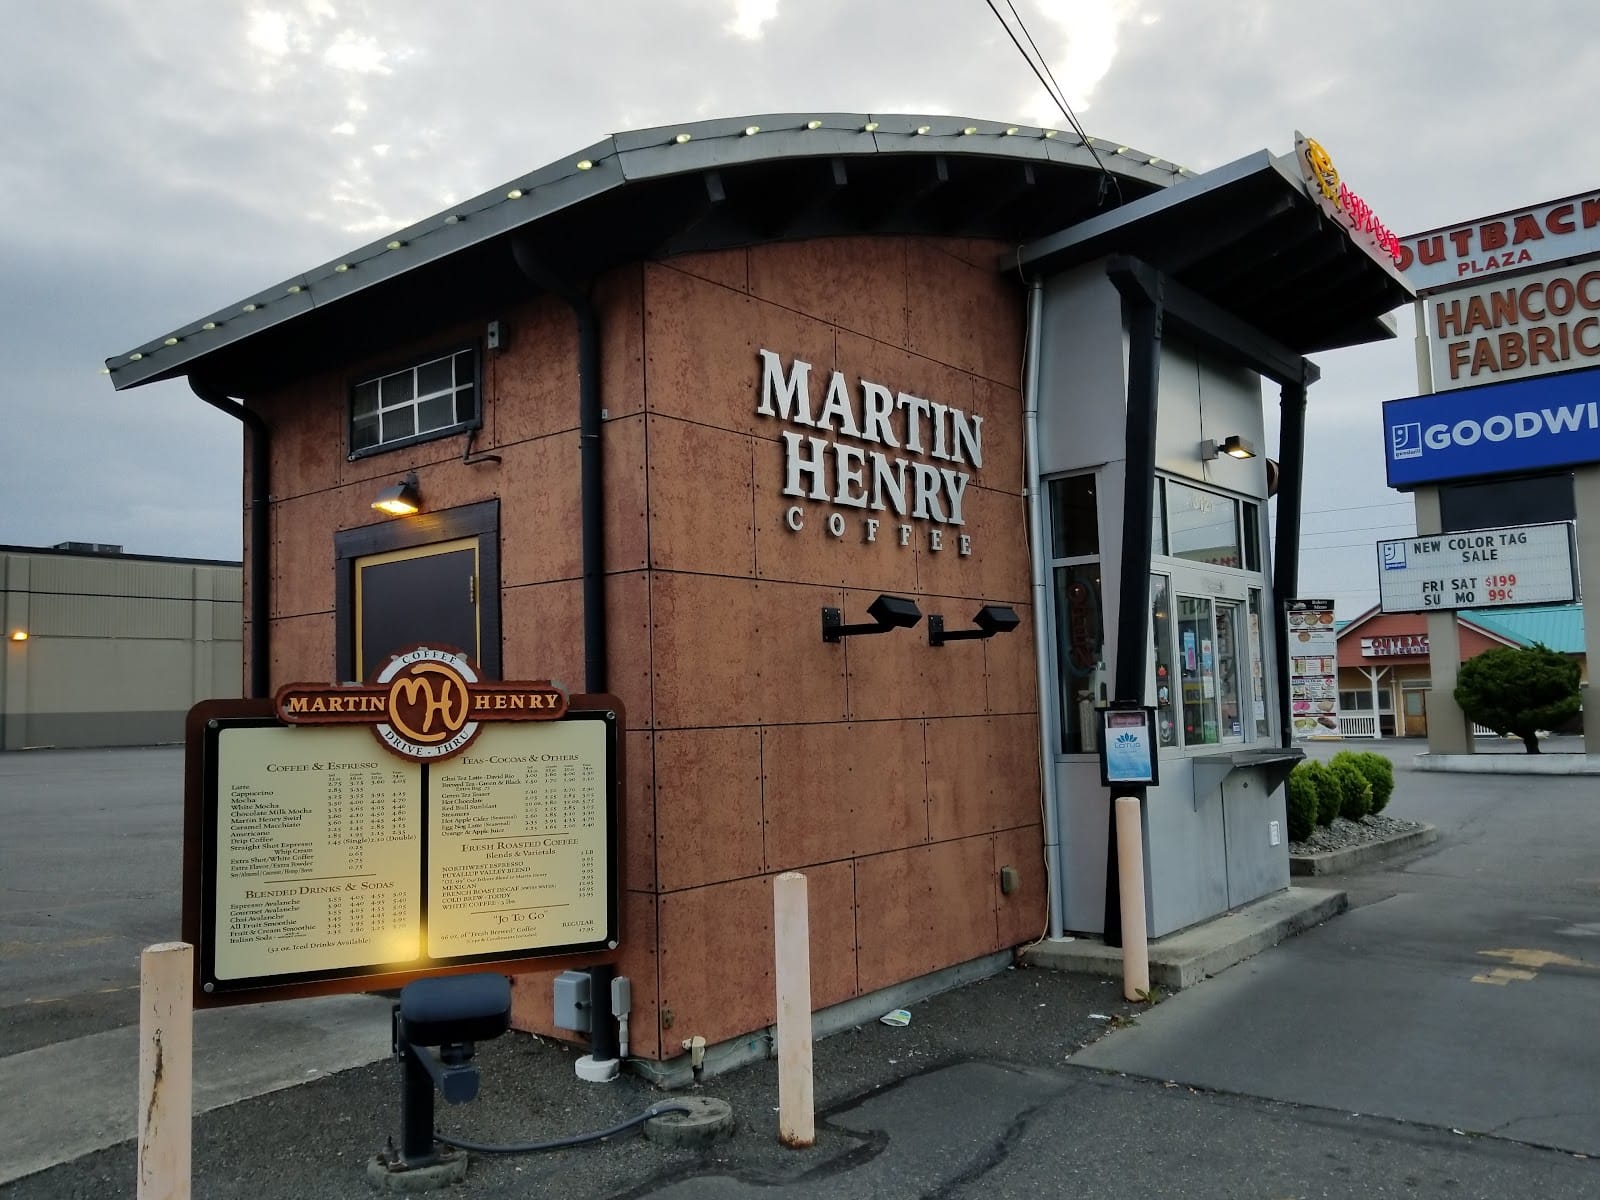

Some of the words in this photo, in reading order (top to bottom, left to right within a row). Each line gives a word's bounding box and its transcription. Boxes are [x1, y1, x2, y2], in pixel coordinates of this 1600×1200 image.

[1458, 249, 1532, 276] PLAZA
[757, 349, 983, 469] MARTIN
[1425, 401, 1598, 450] GOODWI
[782, 431, 970, 525] HENRY
[786, 506, 971, 555] COFFEE
[1414, 541, 1440, 554] NEW
[1449, 537, 1494, 550] COLOR
[1499, 533, 1527, 546] TAG
[1462, 549, 1498, 562] SALE
[1423, 581, 1444, 592] FRI
[1451, 578, 1477, 590] SAT
[1425, 595, 1440, 605] SU
[1456, 592, 1474, 603] MO
[402, 651, 457, 665] COFFEE
[288, 697, 386, 713] MARTIN
[475, 694, 559, 710] HENRY
[385, 731, 423, 755] DRIVE
[435, 731, 469, 754] THRU
[486, 851, 512, 859] Blends
